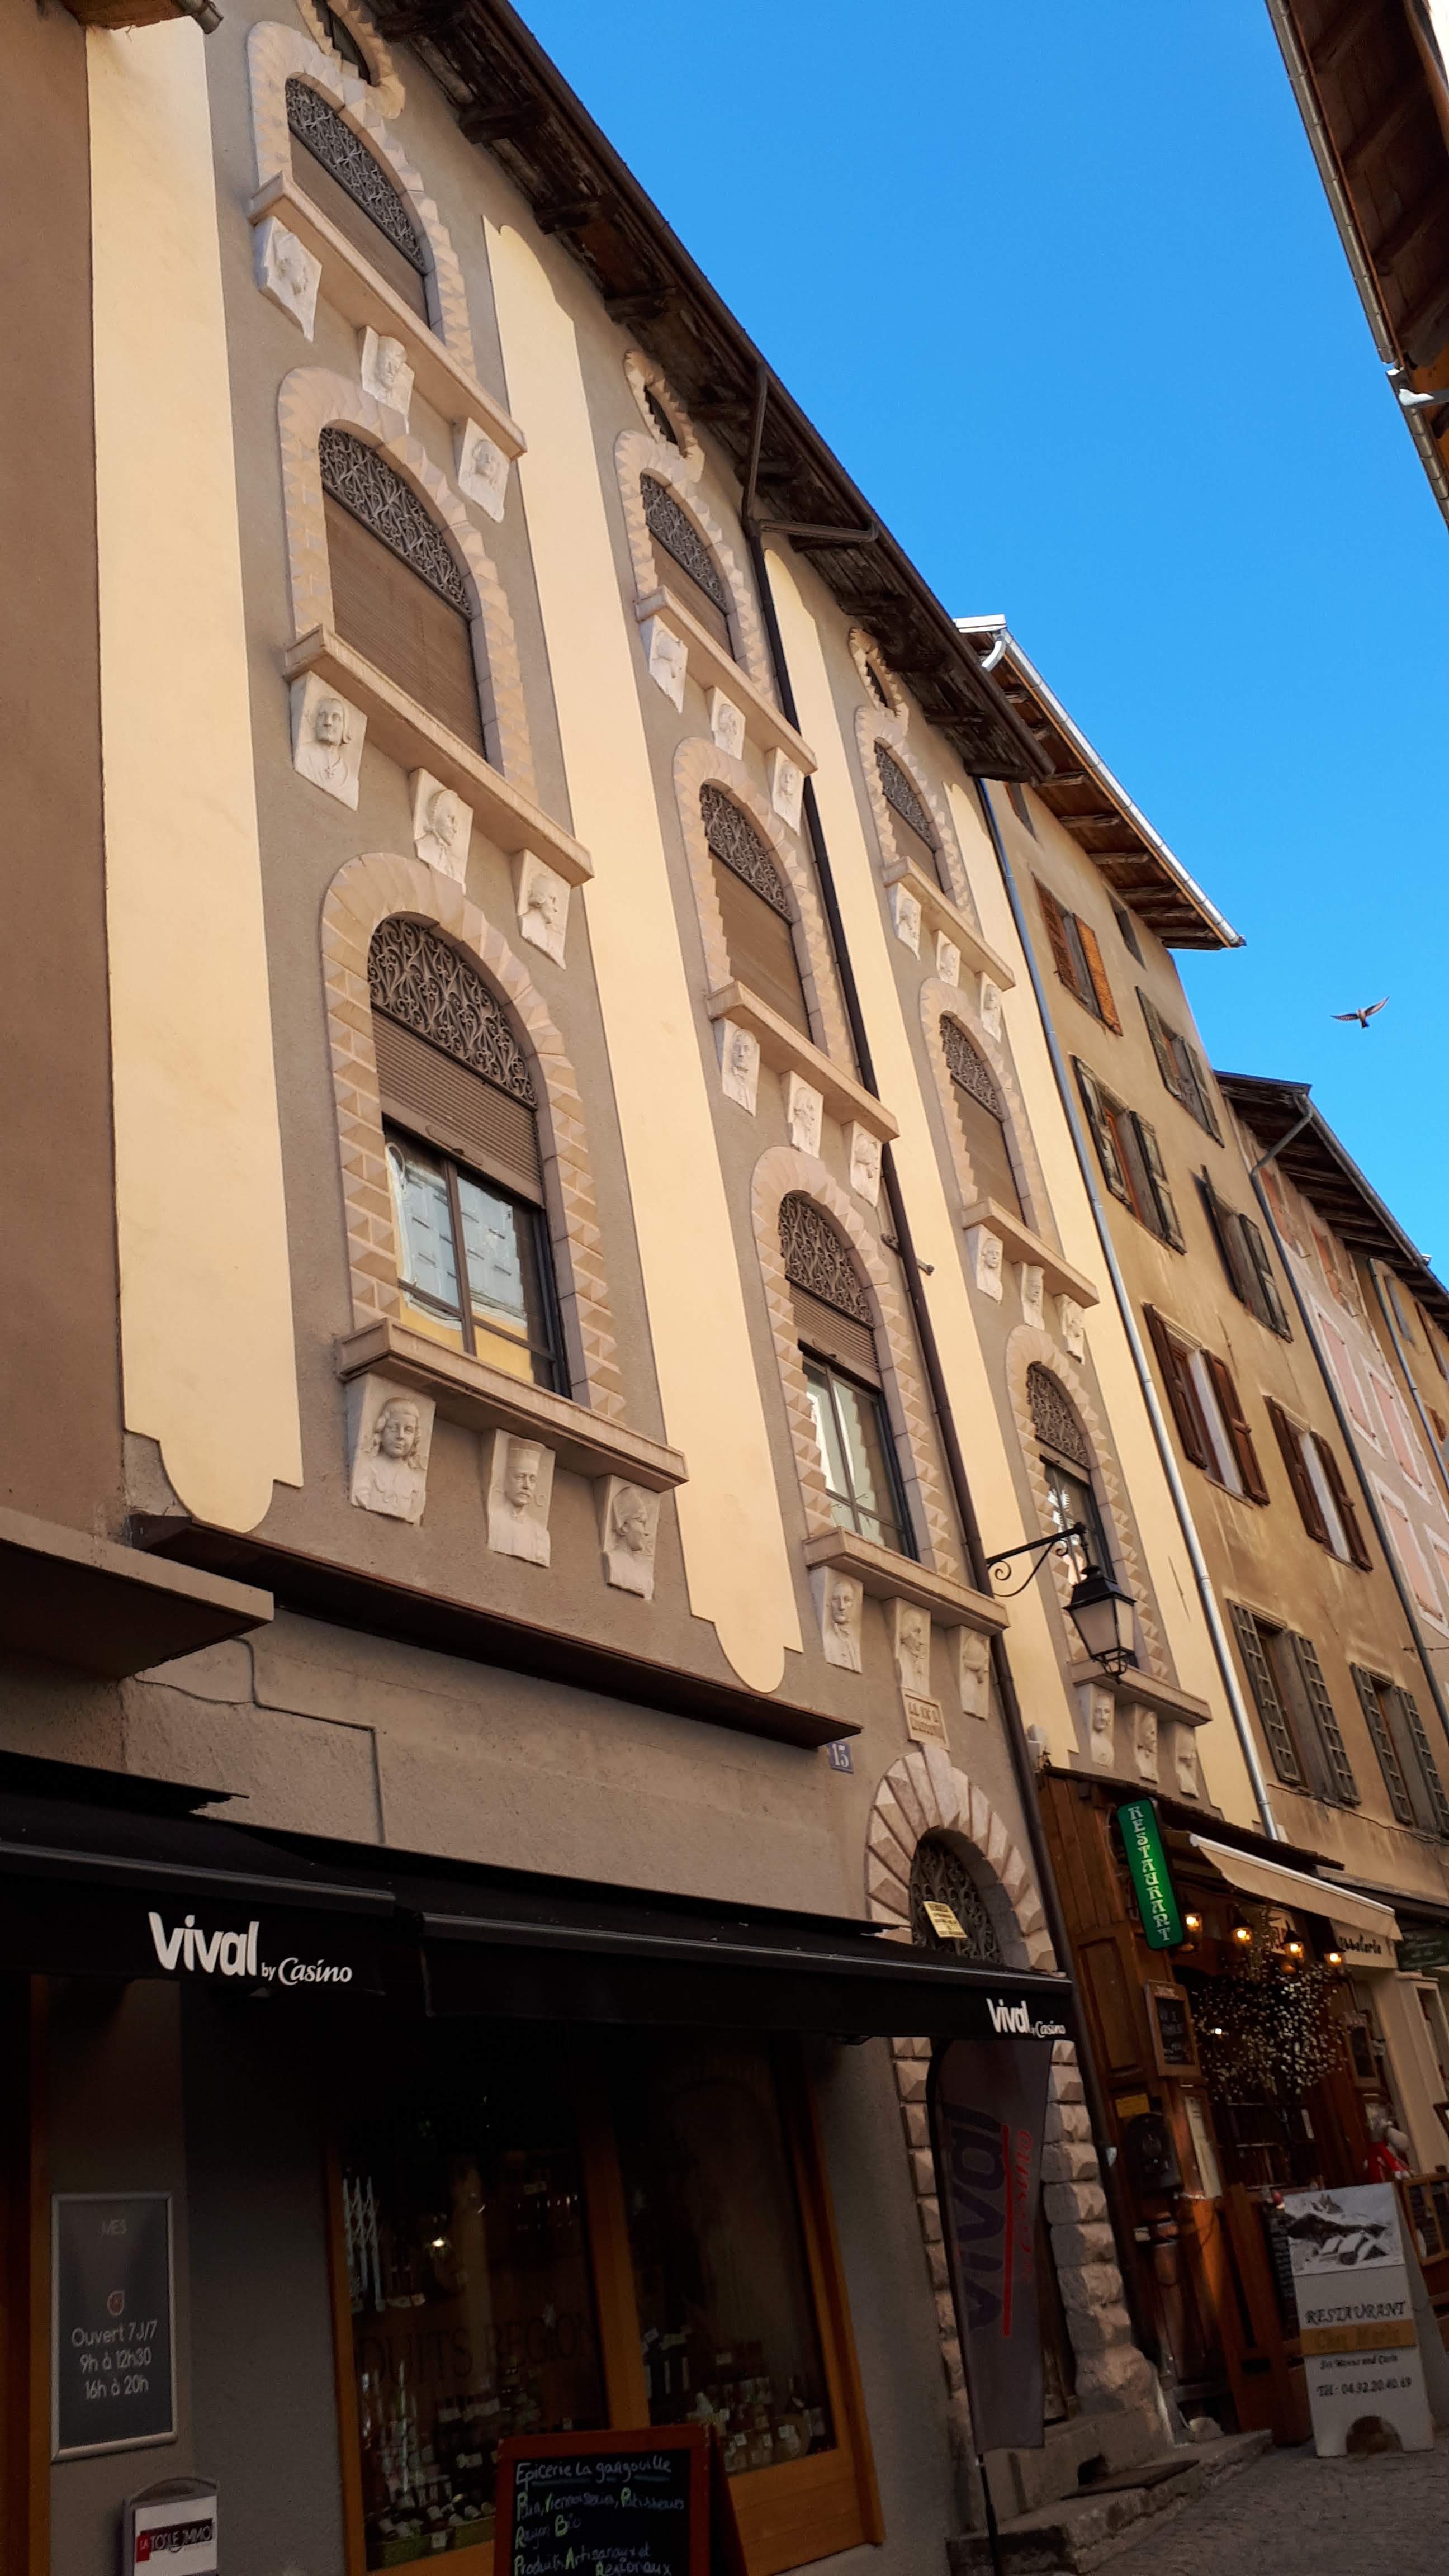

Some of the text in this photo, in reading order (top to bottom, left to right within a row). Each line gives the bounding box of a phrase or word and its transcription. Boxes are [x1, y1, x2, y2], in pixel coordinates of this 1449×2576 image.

[832, 1743, 849, 1767] 15
[1127, 1805, 1172, 1942] RESTAURANT
[148, 1911, 353, 1986] Vival by Casino
[986, 1997, 1031, 2033] Vival
[1035, 2020, 1066, 2038] Casino
[1305, 2301, 1405, 2325] RESTAURANT
[71, 2319, 157, 2347] Ouvert 7J/7
[79, 2347, 152, 2374] 9h à 12h30
[84, 2375, 149, 2400] 16h à 20h
[515, 2461, 572, 2491] Epicerie
[554, 2513, 582, 2538] Bio
